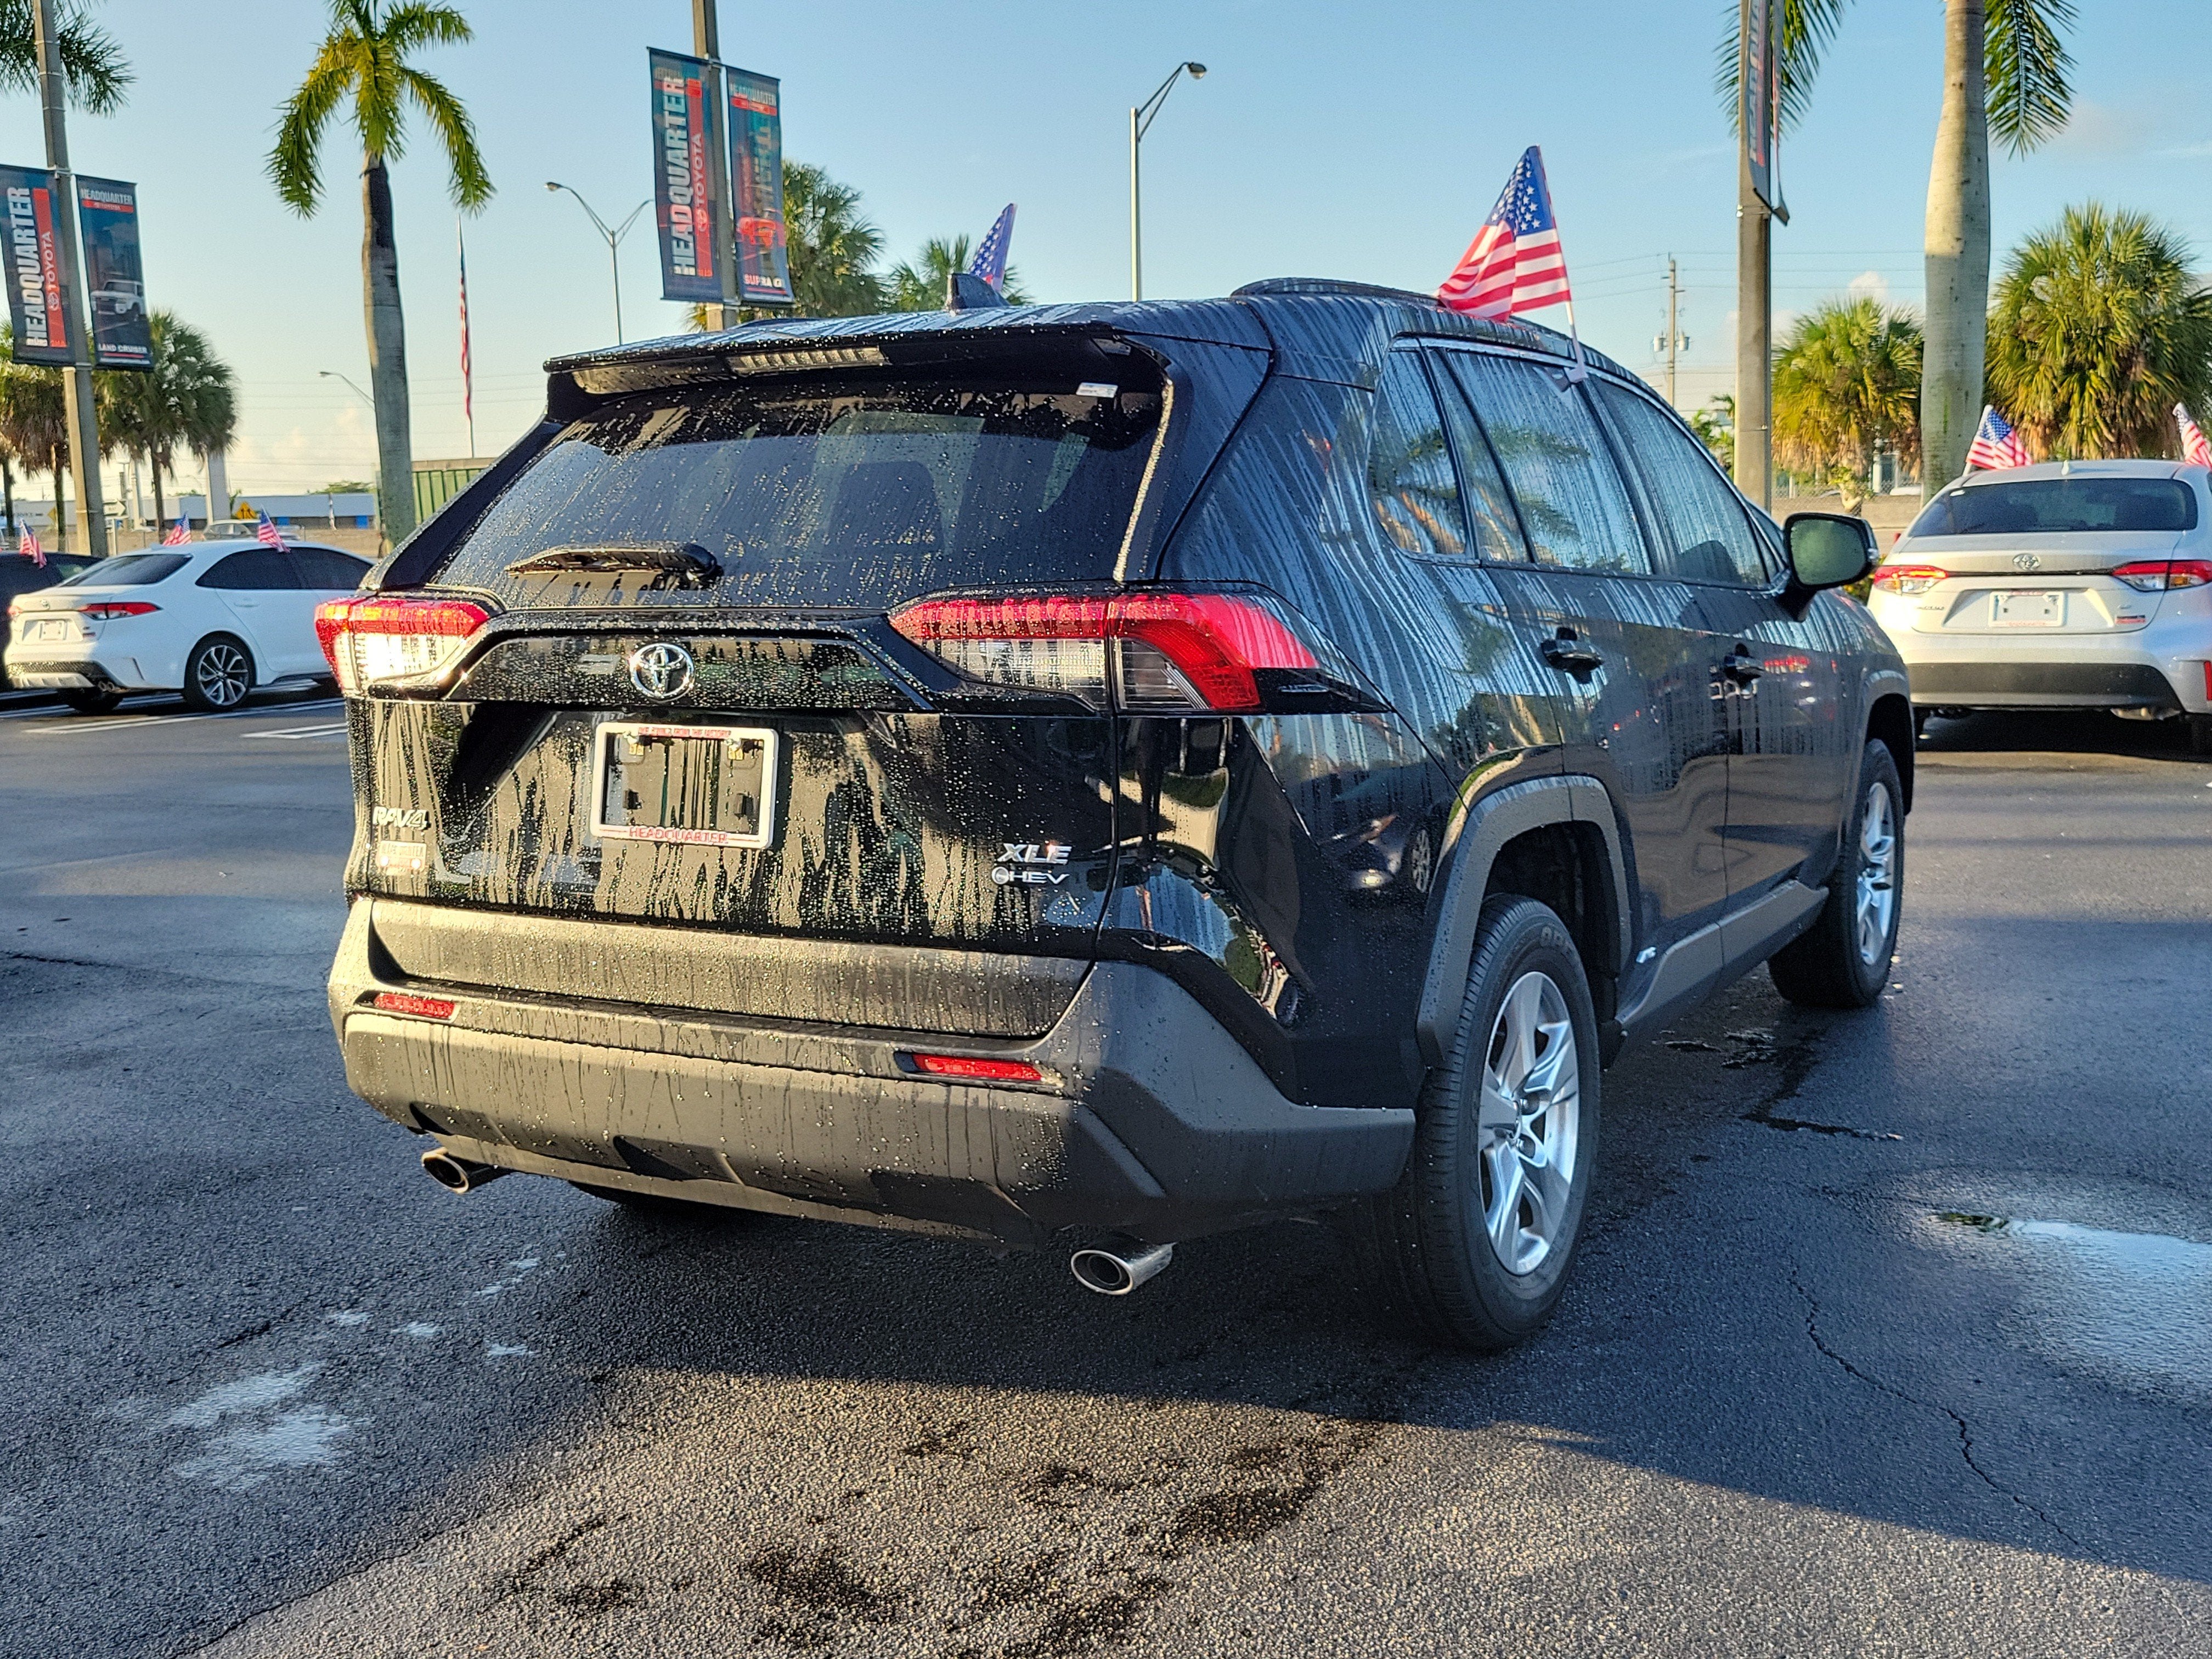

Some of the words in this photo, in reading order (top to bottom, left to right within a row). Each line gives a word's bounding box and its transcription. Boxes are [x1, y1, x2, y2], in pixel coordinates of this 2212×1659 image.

[663, 76, 696, 276] HEADQUARTER
[691, 133, 707, 210] TOYOTA
[80, 187, 133, 205] HEADQUARTER
[7, 187, 48, 347] HEADQUARTER
[41, 230, 59, 290] TOYOTA
[372, 805, 428, 830] RAV4
[629, 826, 729, 844] HEADQUARTER
[996, 843, 1072, 865] XLE
